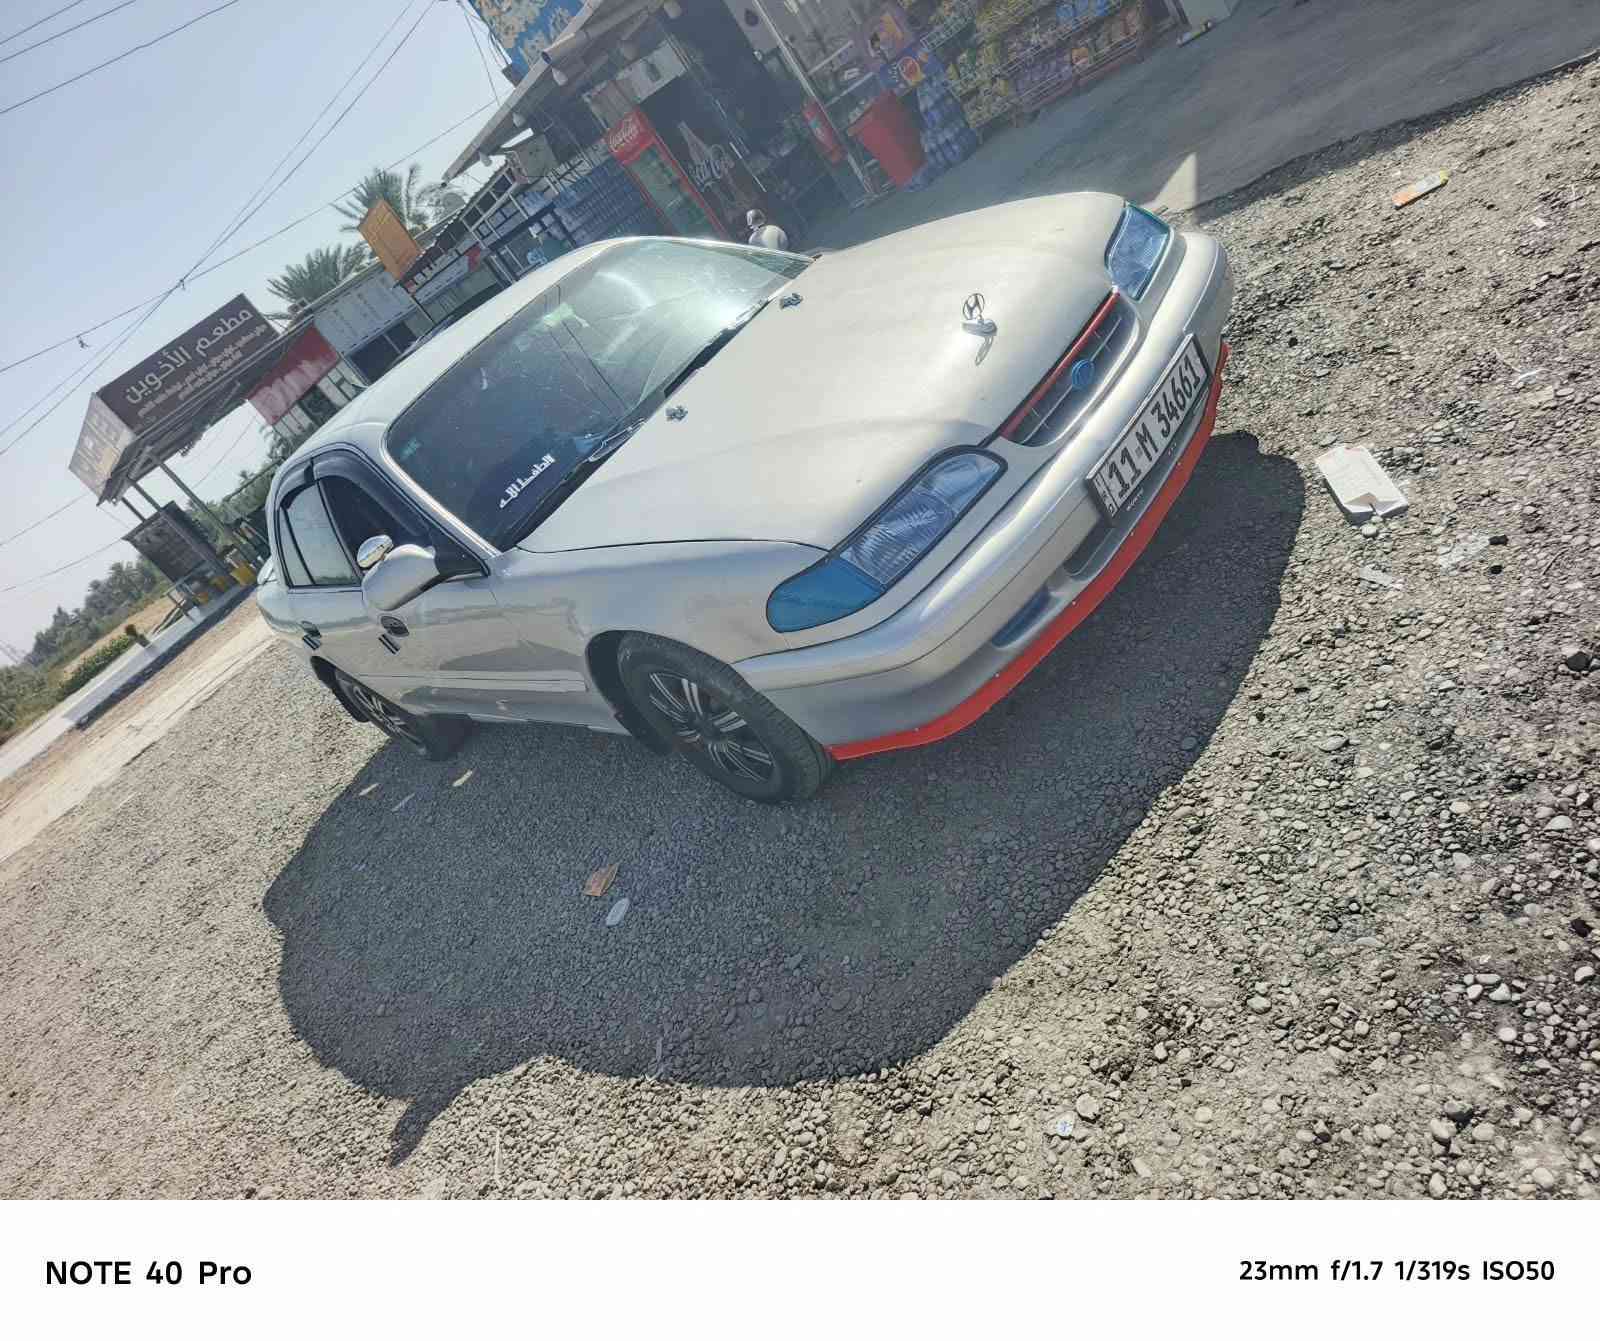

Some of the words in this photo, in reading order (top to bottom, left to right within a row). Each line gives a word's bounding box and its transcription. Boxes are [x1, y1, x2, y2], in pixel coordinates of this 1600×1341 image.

[195, 309, 253, 357] مطعم
[126, 345, 193, 404] الأخوين
[1108, 447, 1142, 500] 11
[1135, 422, 1159, 462] M
[1150, 354, 1202, 438] 34661
